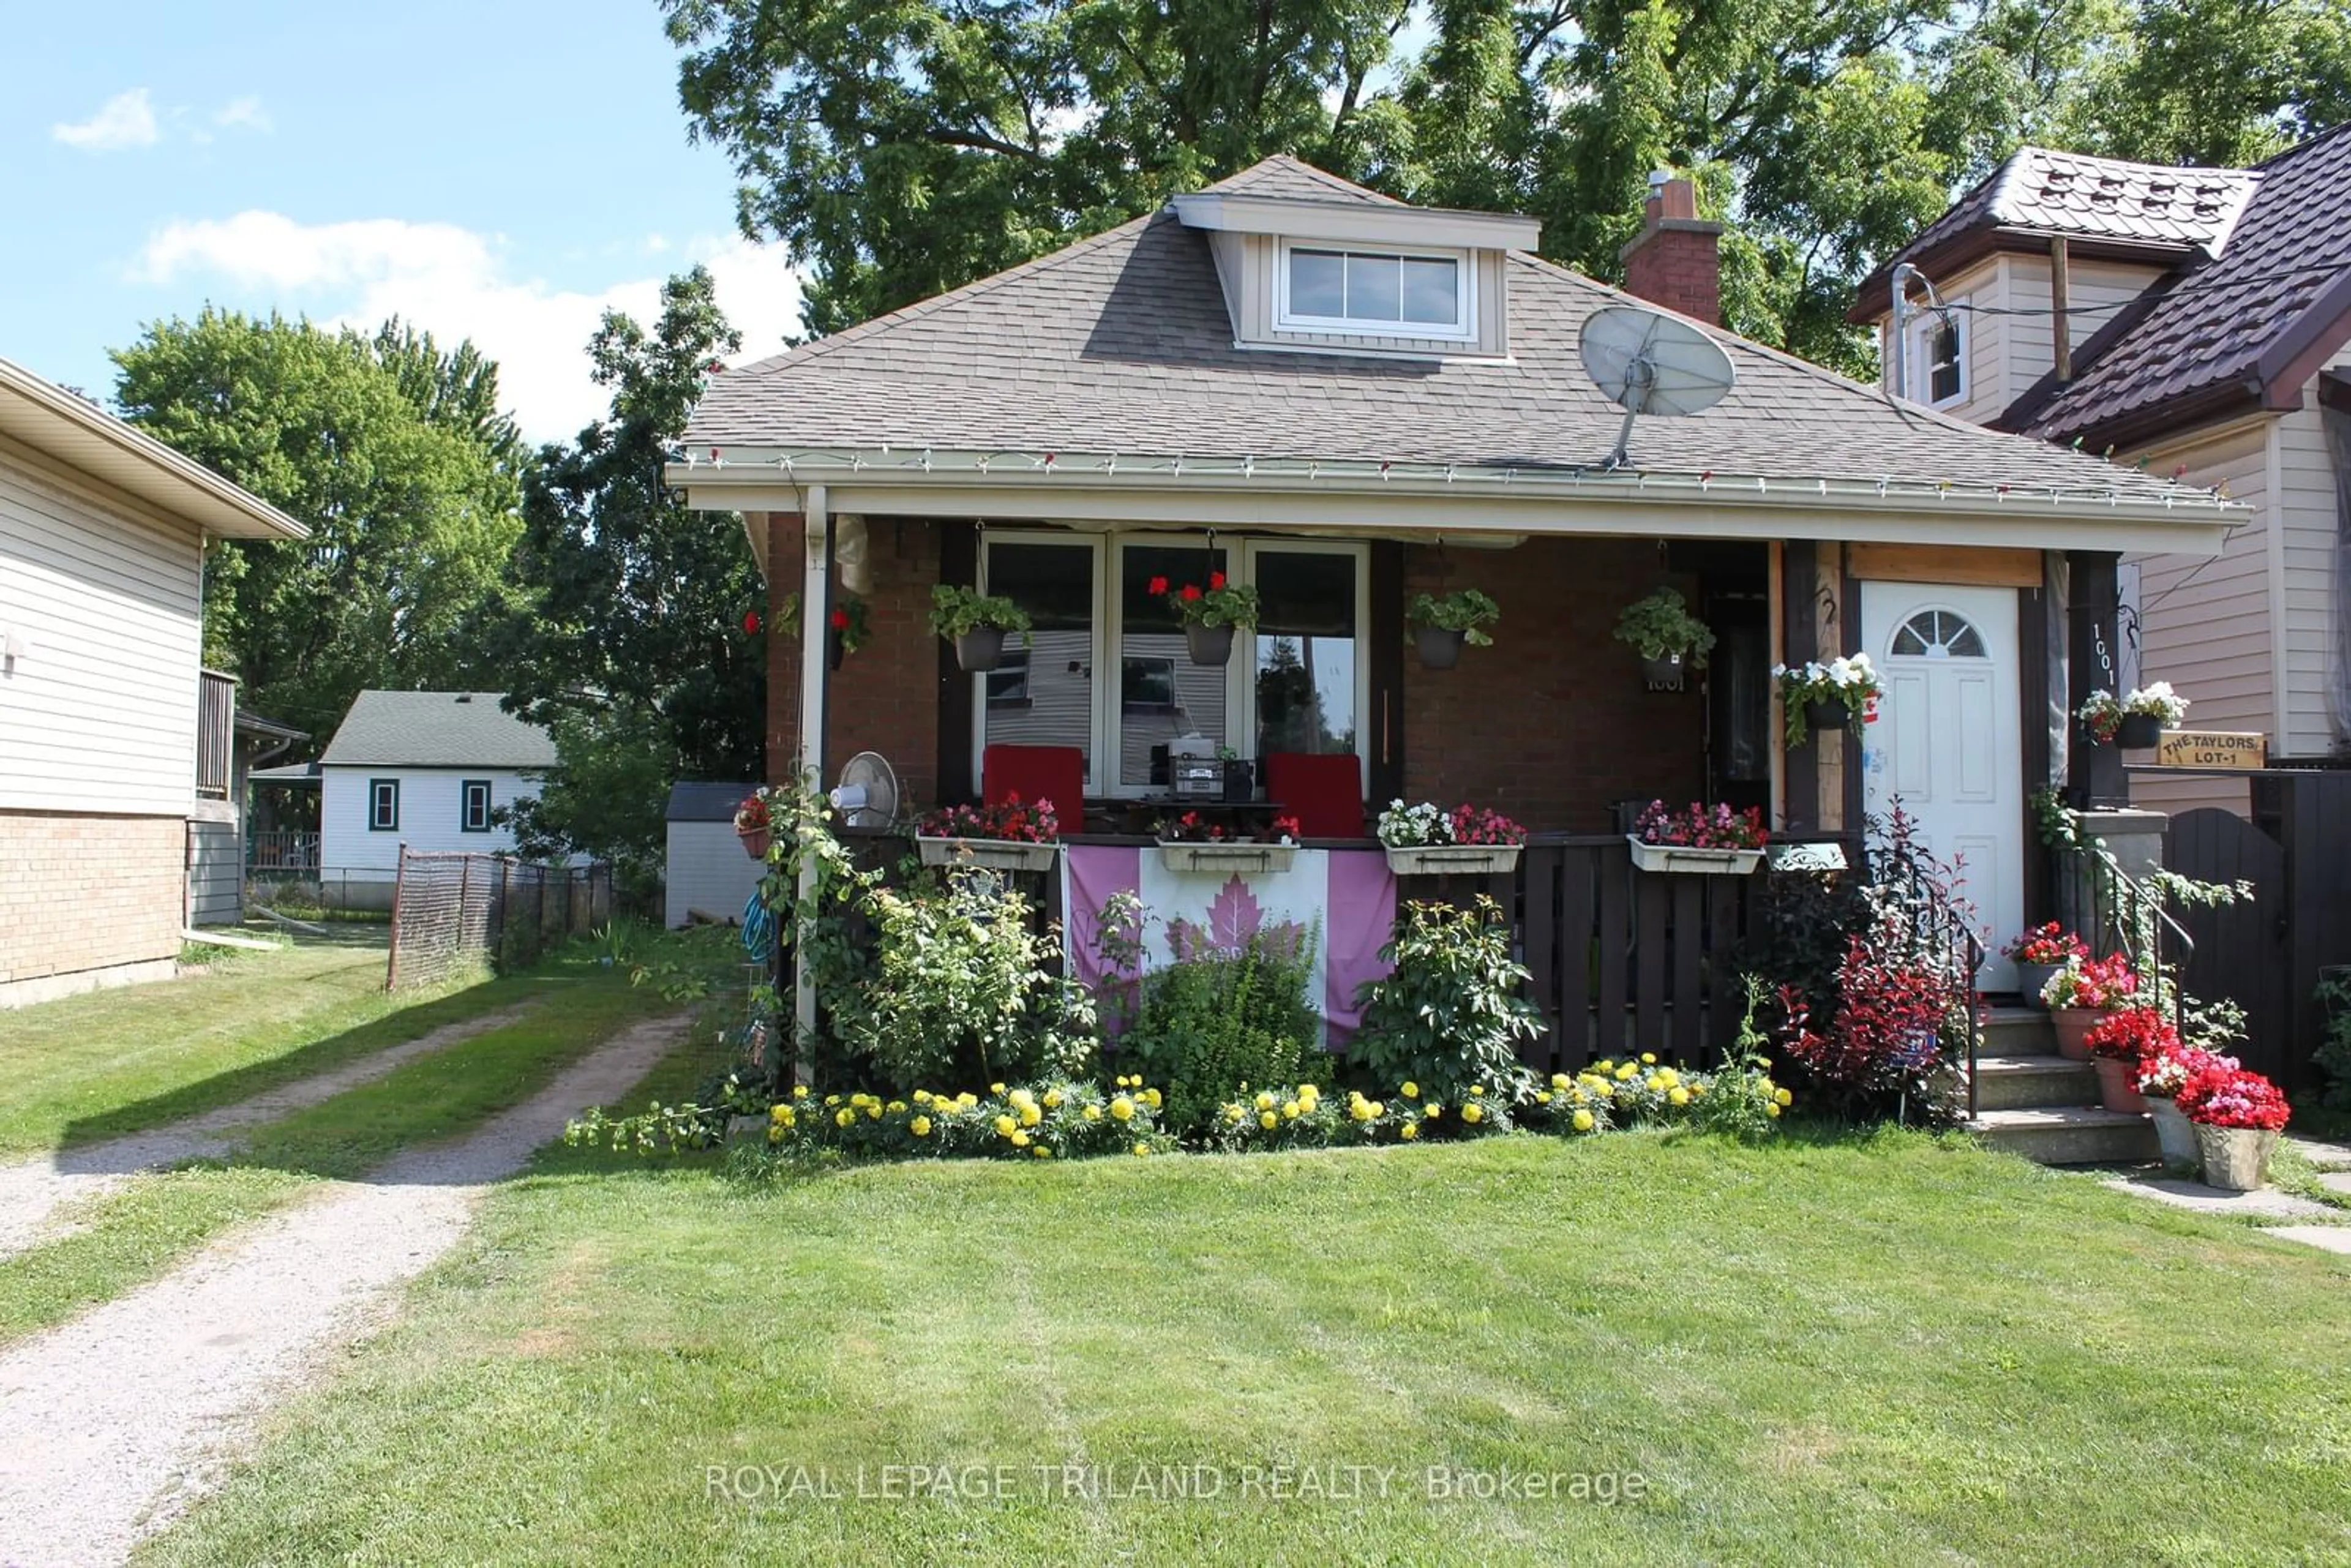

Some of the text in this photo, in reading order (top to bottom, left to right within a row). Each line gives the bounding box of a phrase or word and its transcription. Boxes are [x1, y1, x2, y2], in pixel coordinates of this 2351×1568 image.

[2094, 623, 2114, 685] 1001
[2164, 735, 2192, 756] THE
[2195, 752, 2237, 765] LOT-1
